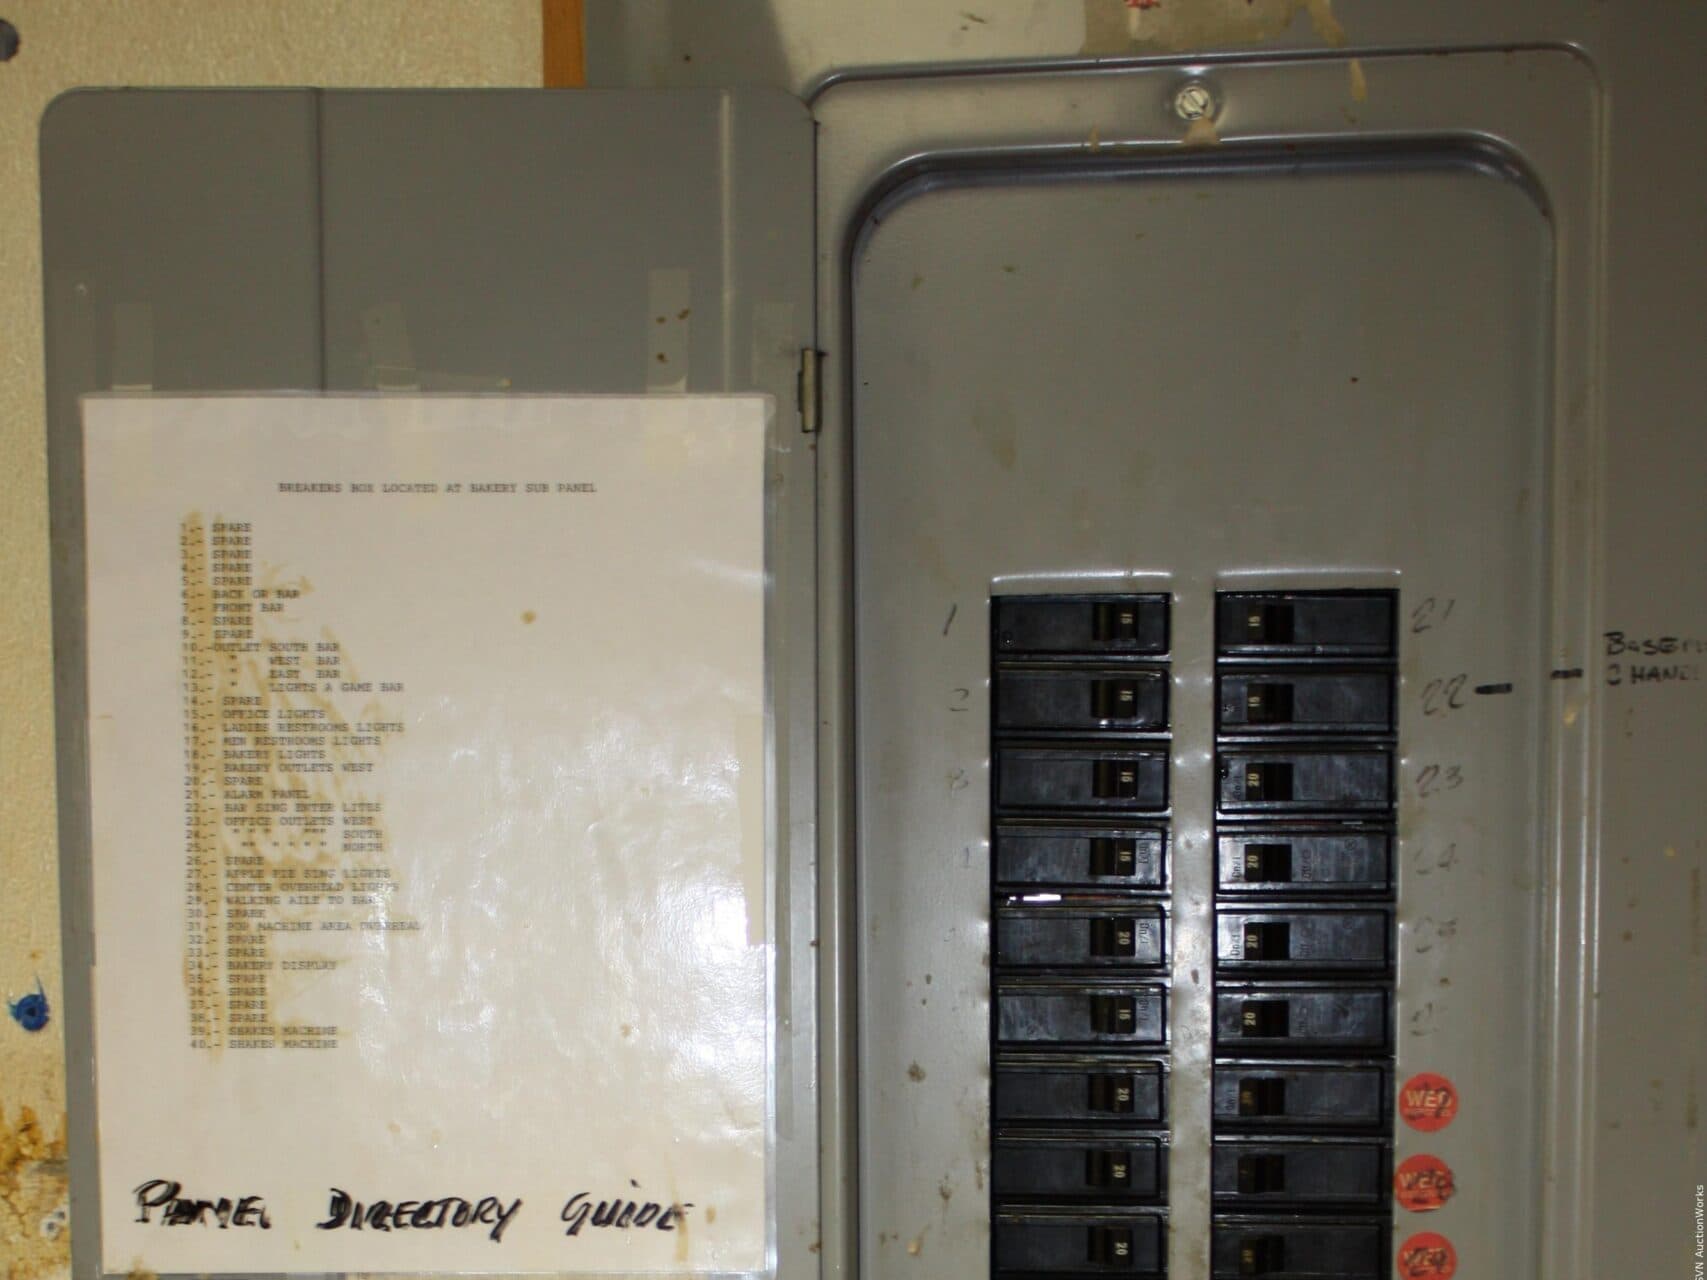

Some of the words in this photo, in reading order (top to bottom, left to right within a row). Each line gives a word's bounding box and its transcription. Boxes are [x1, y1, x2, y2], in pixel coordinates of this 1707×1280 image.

[278, 482, 343, 494] BREAKERS
[351, 482, 374, 494] BOX
[382, 482, 439, 494] LOCATED
[446, 482, 462, 494] AT
[471, 482, 516, 494] BAKERY
[525, 482, 550, 494] SUB
[557, 482, 597, 494] PANEL
[212, 523, 252, 533] SPARE
[212, 536, 252, 546] SPARE
[212, 549, 252, 559] SPARE
[212, 563, 252, 572] SPARE
[212, 577, 252, 586] SPARE
[212, 590, 244, 599] BACK
[276, 590, 300, 599] BAR
[212, 603, 252, 612] FRONT
[260, 603, 284, 612] BAR
[213, 616, 253, 626] SPARE
[213, 629, 254, 639] SPARE
[268, 643, 308, 652] SOUTH
[316, 643, 340, 652] BAR
[269, 656, 301, 665] WEST
[316, 656, 341, 665] BAR
[269, 670, 300, 679] EAST
[316, 670, 341, 679] BAR
[268, 683, 317, 692] LIGHTS
[341, 683, 372, 692] GAME
[380, 683, 404, 692] BAR
[1421, 673, 1468, 715] 22
[222, 696, 263, 705] SPARE
[222, 710, 269, 719] OFFICE
[277, 710, 327, 719] LIGHTS
[222, 723, 268, 732] LADIES
[277, 723, 349, 732] RESTROOMS
[356, 723, 404, 732] LIGHTS
[223, 736, 246, 745] MEN
[254, 736, 325, 745] RESTROOMS
[333, 736, 382, 745] LIGHTS
[223, 750, 270, 759] BAKERY
[279, 750, 326, 759] LIGHTS
[223, 763, 271, 772] BAKERY
[279, 763, 334, 772] OUTLETS
[342, 763, 374, 772] WEST
[224, 777, 264, 786] SPARE
[224, 790, 263, 800] ALARM
[271, 790, 310, 800] PANEL
[224, 803, 248, 813] BAR
[224, 817, 272, 826] OFFICE
[279, 817, 334, 826] OUTLETS
[343, 817, 374, 826] WEST
[344, 830, 383, 839] SOUTH
[344, 843, 384, 852] NORTH
[224, 856, 264, 866] SPARE
[225, 869, 265, 879] APPLE
[272, 869, 296, 879] PIE
[226, 896, 281, 905] WALKING
[327, 896, 344, 905] TO
[226, 909, 266, 918] SPARE
[258, 922, 312, 931] MACHINE
[320, 922, 352, 931] AREA
[227, 935, 266, 944] SPARE
[227, 948, 266, 957] SPARE
[227, 961, 274, 970] BAKERY
[282, 961, 338, 970] DISPLAY
[227, 974, 266, 984] SPARE
[227, 987, 267, 996] SPARE
[228, 1001, 268, 1010] SPARE
[228, 1014, 268, 1023] SPARE
[227, 1026, 276, 1036] SHAKES
[282, 1026, 338, 1036] MACHINE
[229, 1040, 276, 1049] SHAKES
[283, 1040, 339, 1049] MACHINE
[316, 1187, 523, 1243] DIRECTORY
[560, 1179, 694, 1236] GUIDE
